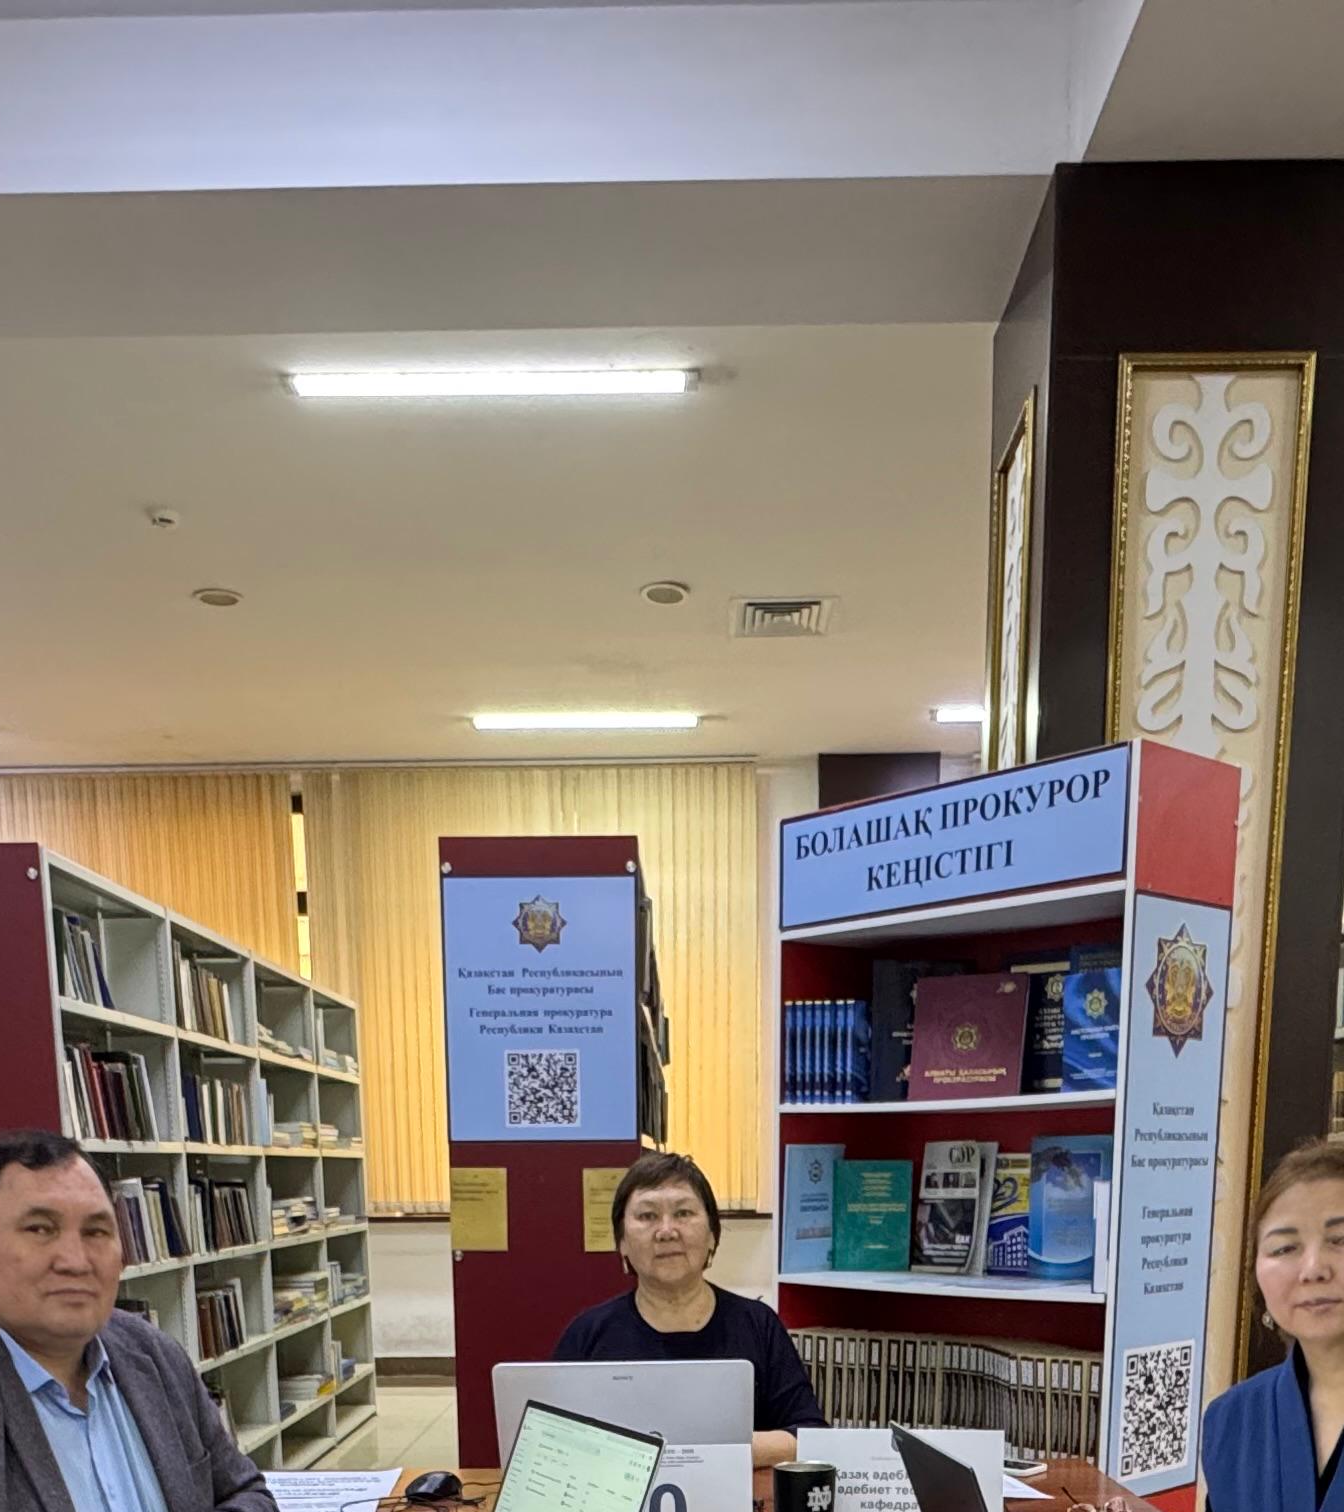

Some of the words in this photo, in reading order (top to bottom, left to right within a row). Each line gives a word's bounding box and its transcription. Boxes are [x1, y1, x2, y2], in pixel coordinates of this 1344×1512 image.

[795, 806, 933, 861] БОЛАШАҚ
[939, 768, 1111, 832] ПРОКУРОР
[866, 839, 1016, 892] КЕҢІСТІГІ
[487, 984, 506, 995] Бас
[509, 984, 595, 997] прокуратурасы
[469, 1007, 539, 1019] Генеральная
[543, 1008, 614, 1019] прокуратура
[479, 1024, 544, 1036] Республики
[548, 1024, 605, 1034] Казахстан
[1131, 1155, 1146, 1167] Бас
[1148, 1157, 1208, 1171] прокуратурасы
[1142, 1206, 1193, 1222] Генеральная
[1141, 1232, 1191, 1248] прокуратура
[872, 1469, 908, 1481] әдеб
[837, 1484, 891, 1496] әдебиет
[895, 1487, 916, 1495] тео
[860, 1499, 918, 1512] кафедра
